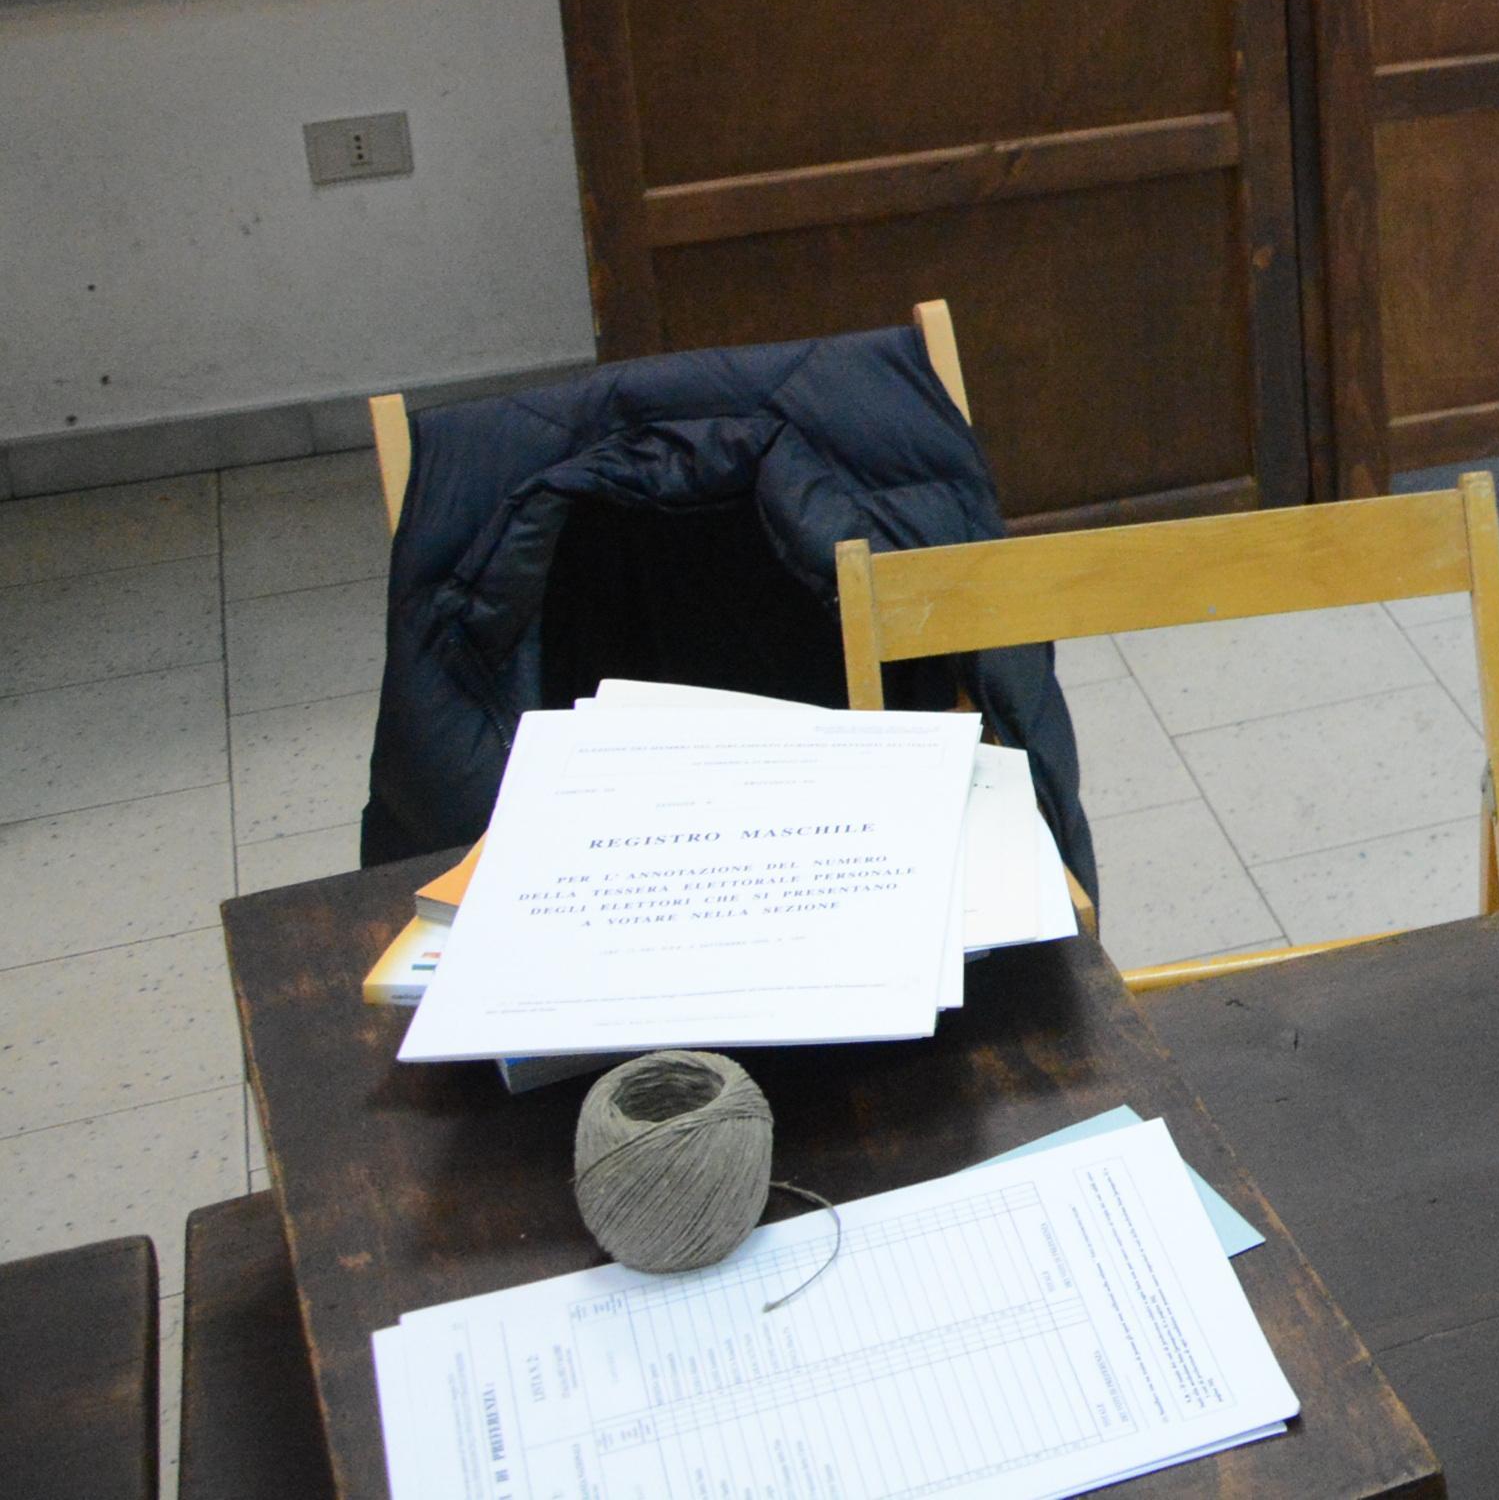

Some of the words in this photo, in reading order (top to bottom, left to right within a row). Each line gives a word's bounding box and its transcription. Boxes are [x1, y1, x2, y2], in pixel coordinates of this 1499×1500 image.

[590, 832, 720, 849] REGISTRO
[742, 824, 873, 838] MASCHILE
[518, 892, 576, 900] DELLA
[594, 886, 668, 896] TESSERA
[684, 876, 796, 890] ELETTORALE
[814, 868, 912, 881] PERSONALE
[557, 876, 590, 884] PER
[629, 865, 751, 879] ANNOTAZIONE
[766, 862, 795, 870] DEL
[814, 856, 886, 866] NUMERO
[530, 905, 586, 915] DEGLI
[600, 898, 690, 911] ELETTORI
[704, 895, 736, 903] CHE
[783, 884, 897, 898] PRESENTANO
[608, 914, 674, 924] VOTARE
[692, 909, 748, 918] NELLA
[763, 902, 836, 914] SEZIONE
